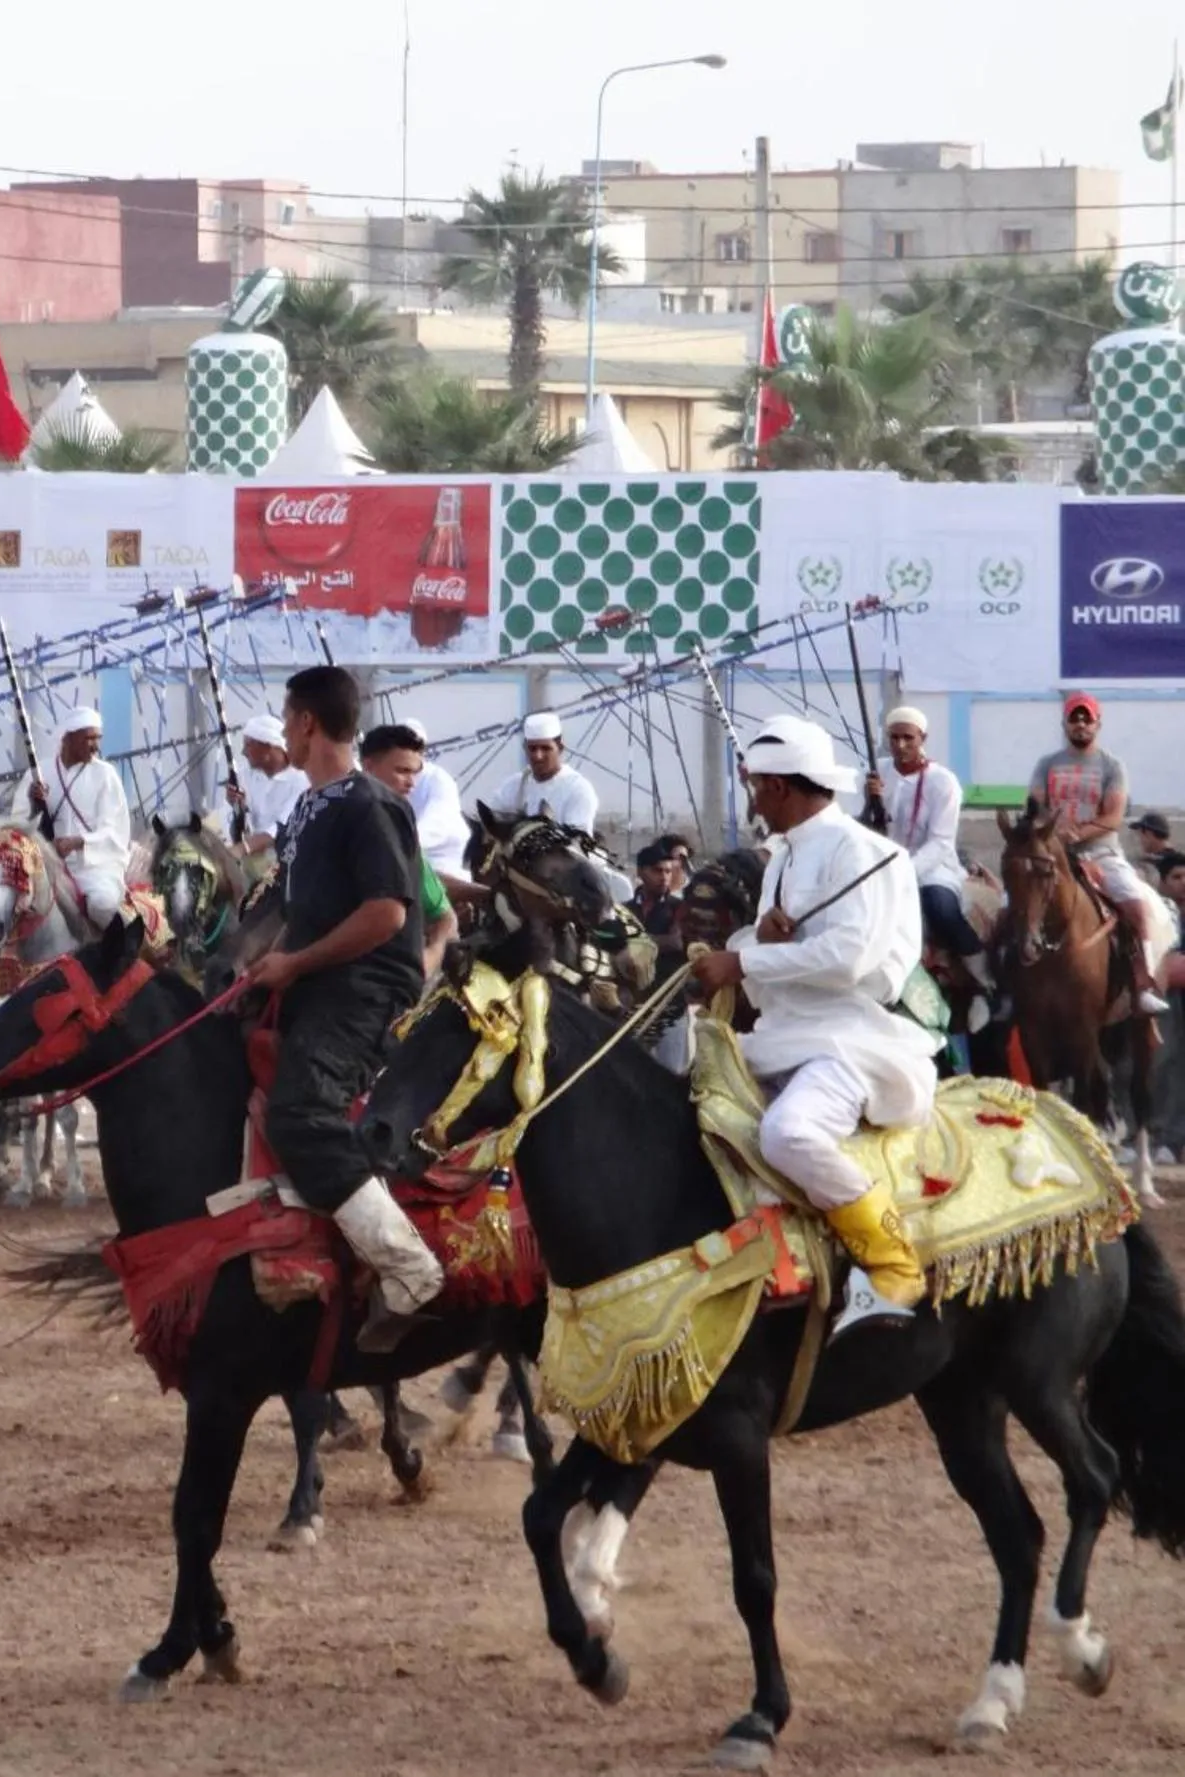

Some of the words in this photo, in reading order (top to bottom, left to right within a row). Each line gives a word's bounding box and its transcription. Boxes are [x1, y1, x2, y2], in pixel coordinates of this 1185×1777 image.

[265, 492, 352, 525] Coca-Cola
[30, 547, 91, 567] TAQA
[151, 546, 210, 566] TAQA
[889, 601, 929, 614] CP
[979, 601, 1021, 615] OCP
[1072, 605, 1181, 625] HYUNDAI
